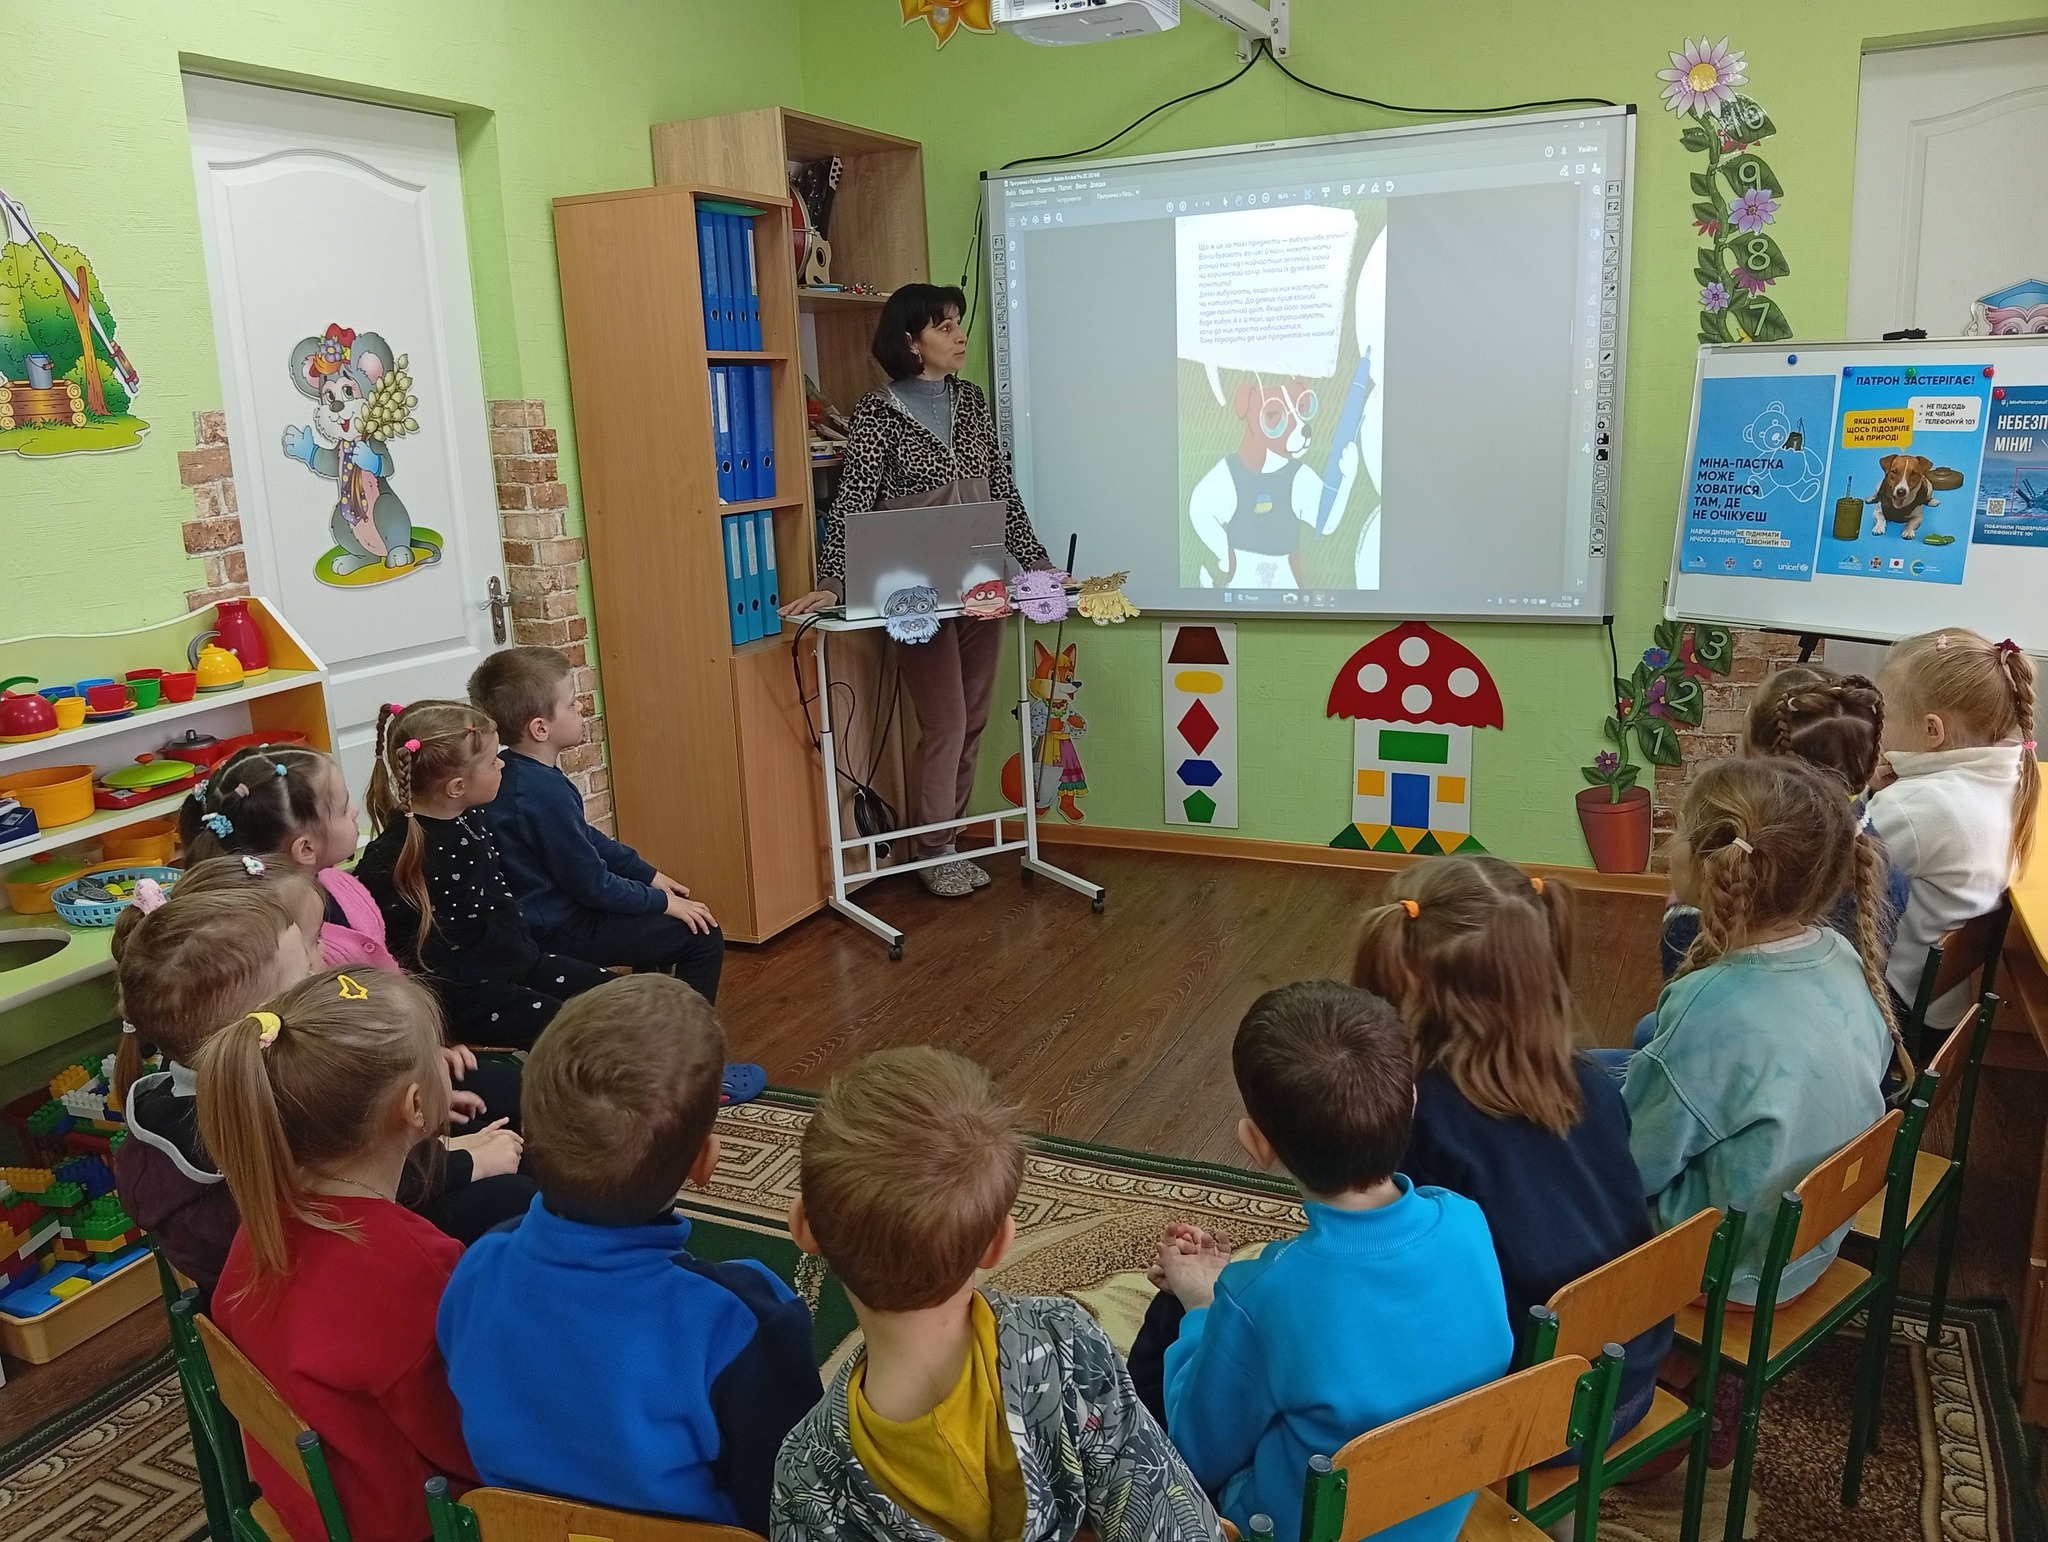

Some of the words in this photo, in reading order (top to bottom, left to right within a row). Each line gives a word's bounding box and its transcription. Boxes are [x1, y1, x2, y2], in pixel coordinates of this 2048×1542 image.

[1739, 161, 1761, 191] 9
[1608, 184, 1620, 193] F1
[1607, 201, 1620, 211] F2
[994, 238, 1003, 246] F1
[1248, 238, 1280, 248] предмети
[995, 253, 1004, 261] F2
[1198, 252, 1214, 260] Вони
[1747, 238, 1771, 271] 8
[1291, 283, 1329, 292] наступити
[1245, 296, 1254, 305] До
[1749, 302, 1771, 336] 7
[1214, 335, 1246, 345] підходити
[1856, 376, 1900, 386] ПАТРОН
[1903, 375, 1976, 386] ЗАСТЕРІГАЄ!
[1934, 410, 1955, 418] ЧІПАЙ
[1854, 418, 1875, 426] ЯКЩО
[1878, 416, 1905, 424] БАЧИШ
[1924, 418, 1963, 426] ТЕЛЕФОНУЙ
[1997, 414, 2048, 430] НЕБЕЗП
[1846, 426, 1870, 434] ЩОСЬ
[1871, 425, 1910, 434] ПІДОЗРІЛЕ
[1866, 434, 1899, 442] ПРИРОДІ
[1994, 436, 2033, 452] МІНИ!
[1699, 458, 1784, 470] МІНА-ПАСТКА
[1697, 470, 1736, 482] МОЖЕ
[1694, 483, 1760, 496] ХОВАТИСЯ
[1694, 496, 1721, 508] ТАМ,
[1724, 498, 1741, 510] ДЕ
[1692, 510, 1708, 520] НЕ
[1710, 510, 1767, 522] ОЧІКУЄШ
[1778, 562, 1801, 572] unicef
[1700, 630, 1728, 660] 3
[1668, 681, 1698, 712] 2
[1653, 726, 1665, 755] 1
